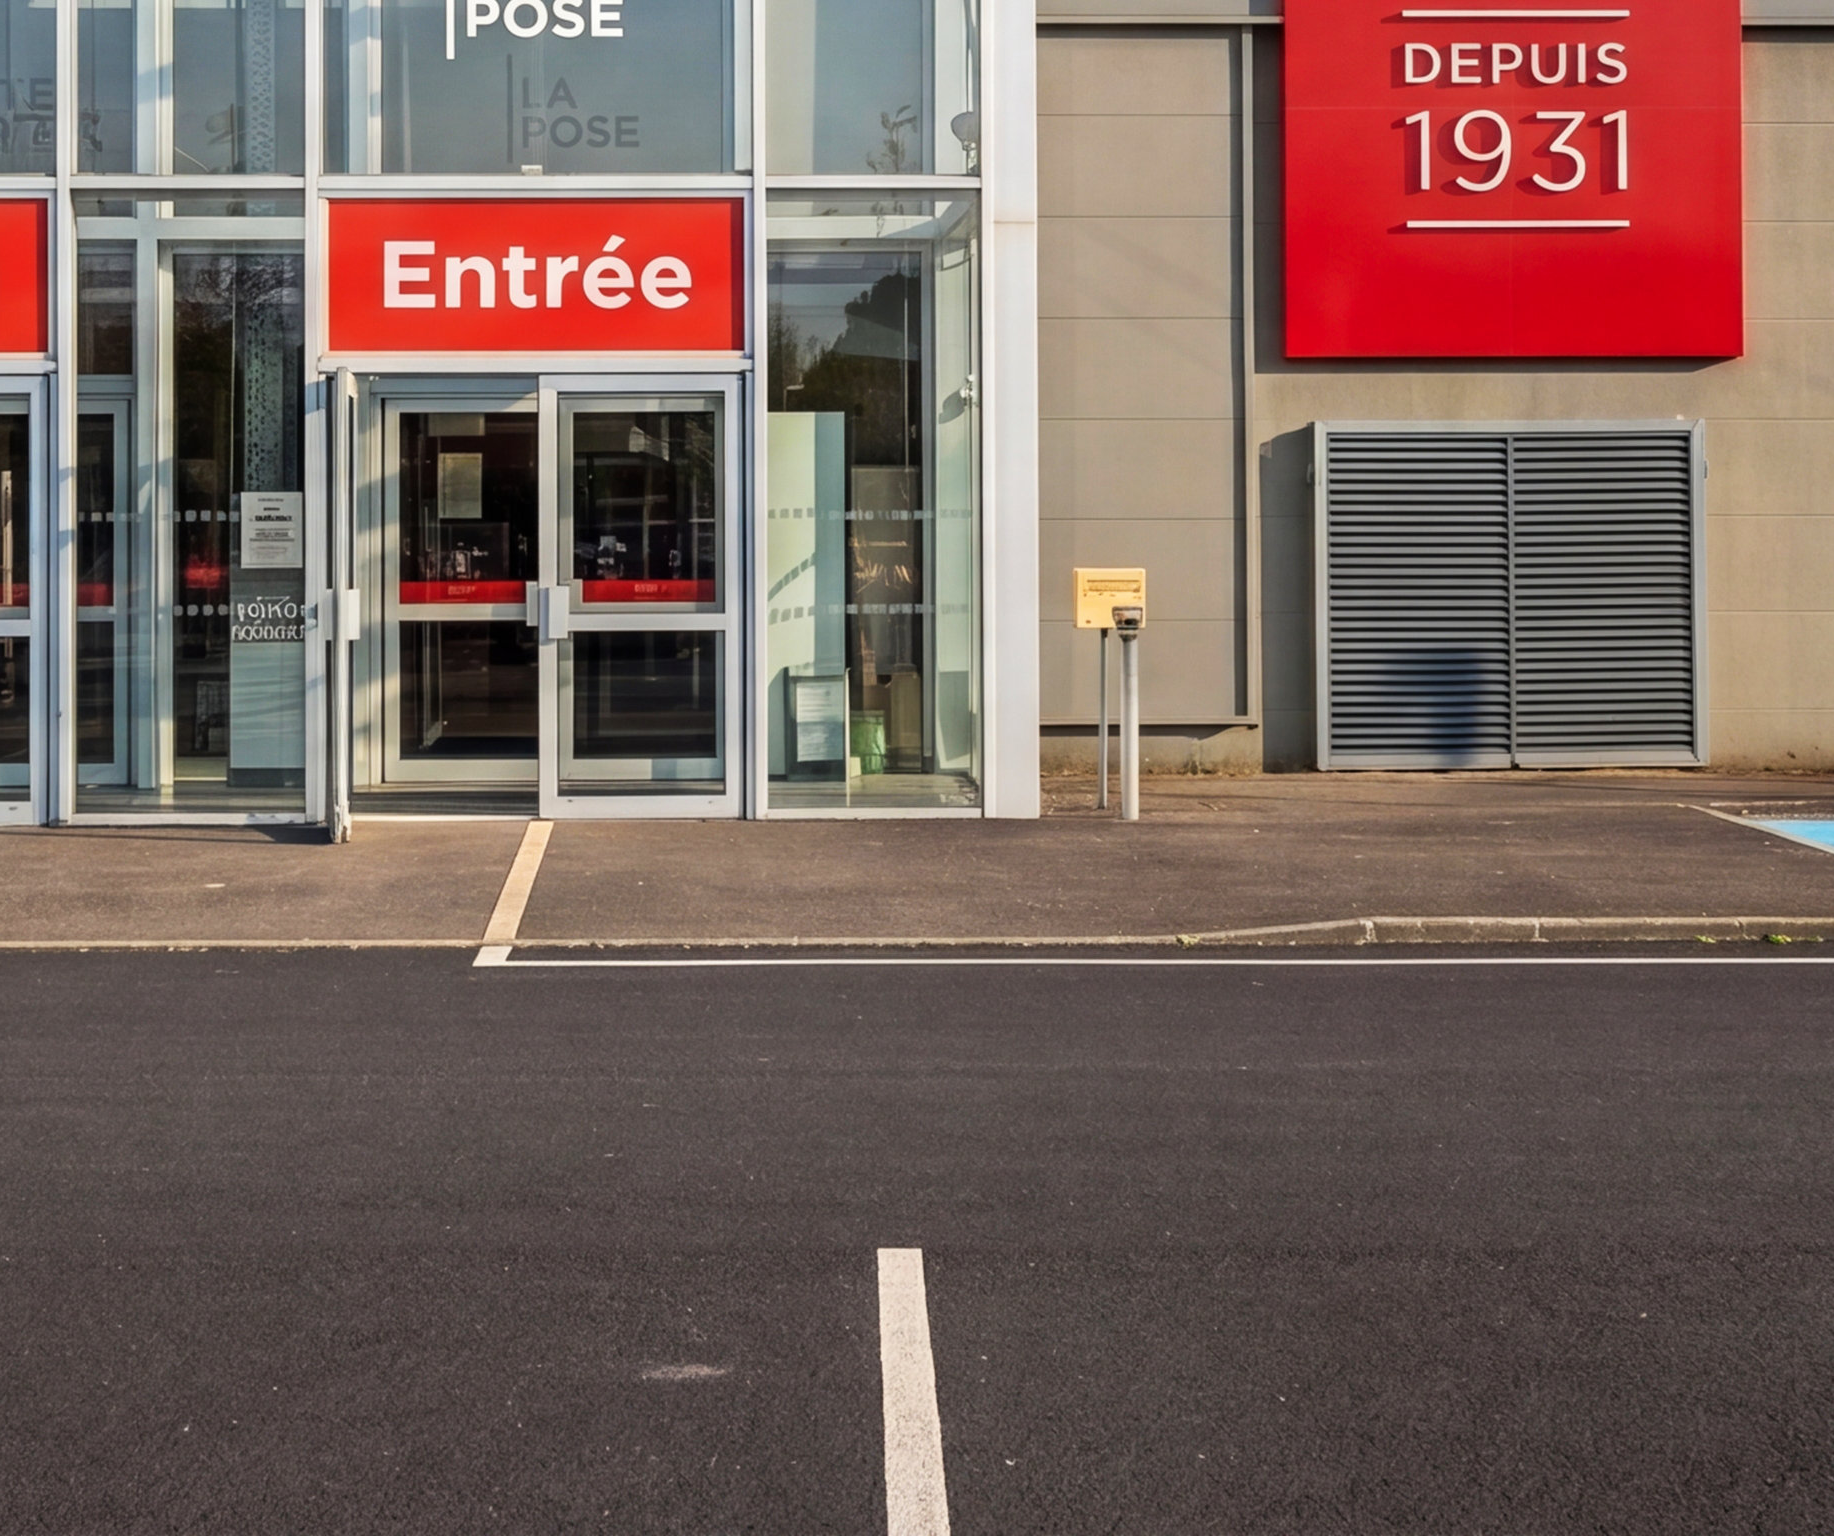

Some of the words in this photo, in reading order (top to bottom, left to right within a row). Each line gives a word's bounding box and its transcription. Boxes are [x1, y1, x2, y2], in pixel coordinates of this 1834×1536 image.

[1404, 41, 1628, 85] DEPUIS
[522, 76, 579, 109] LA
[522, 115, 640, 149] POSE
[1404, 108, 1629, 192] 1931
[383, 234, 693, 310] Entrée
